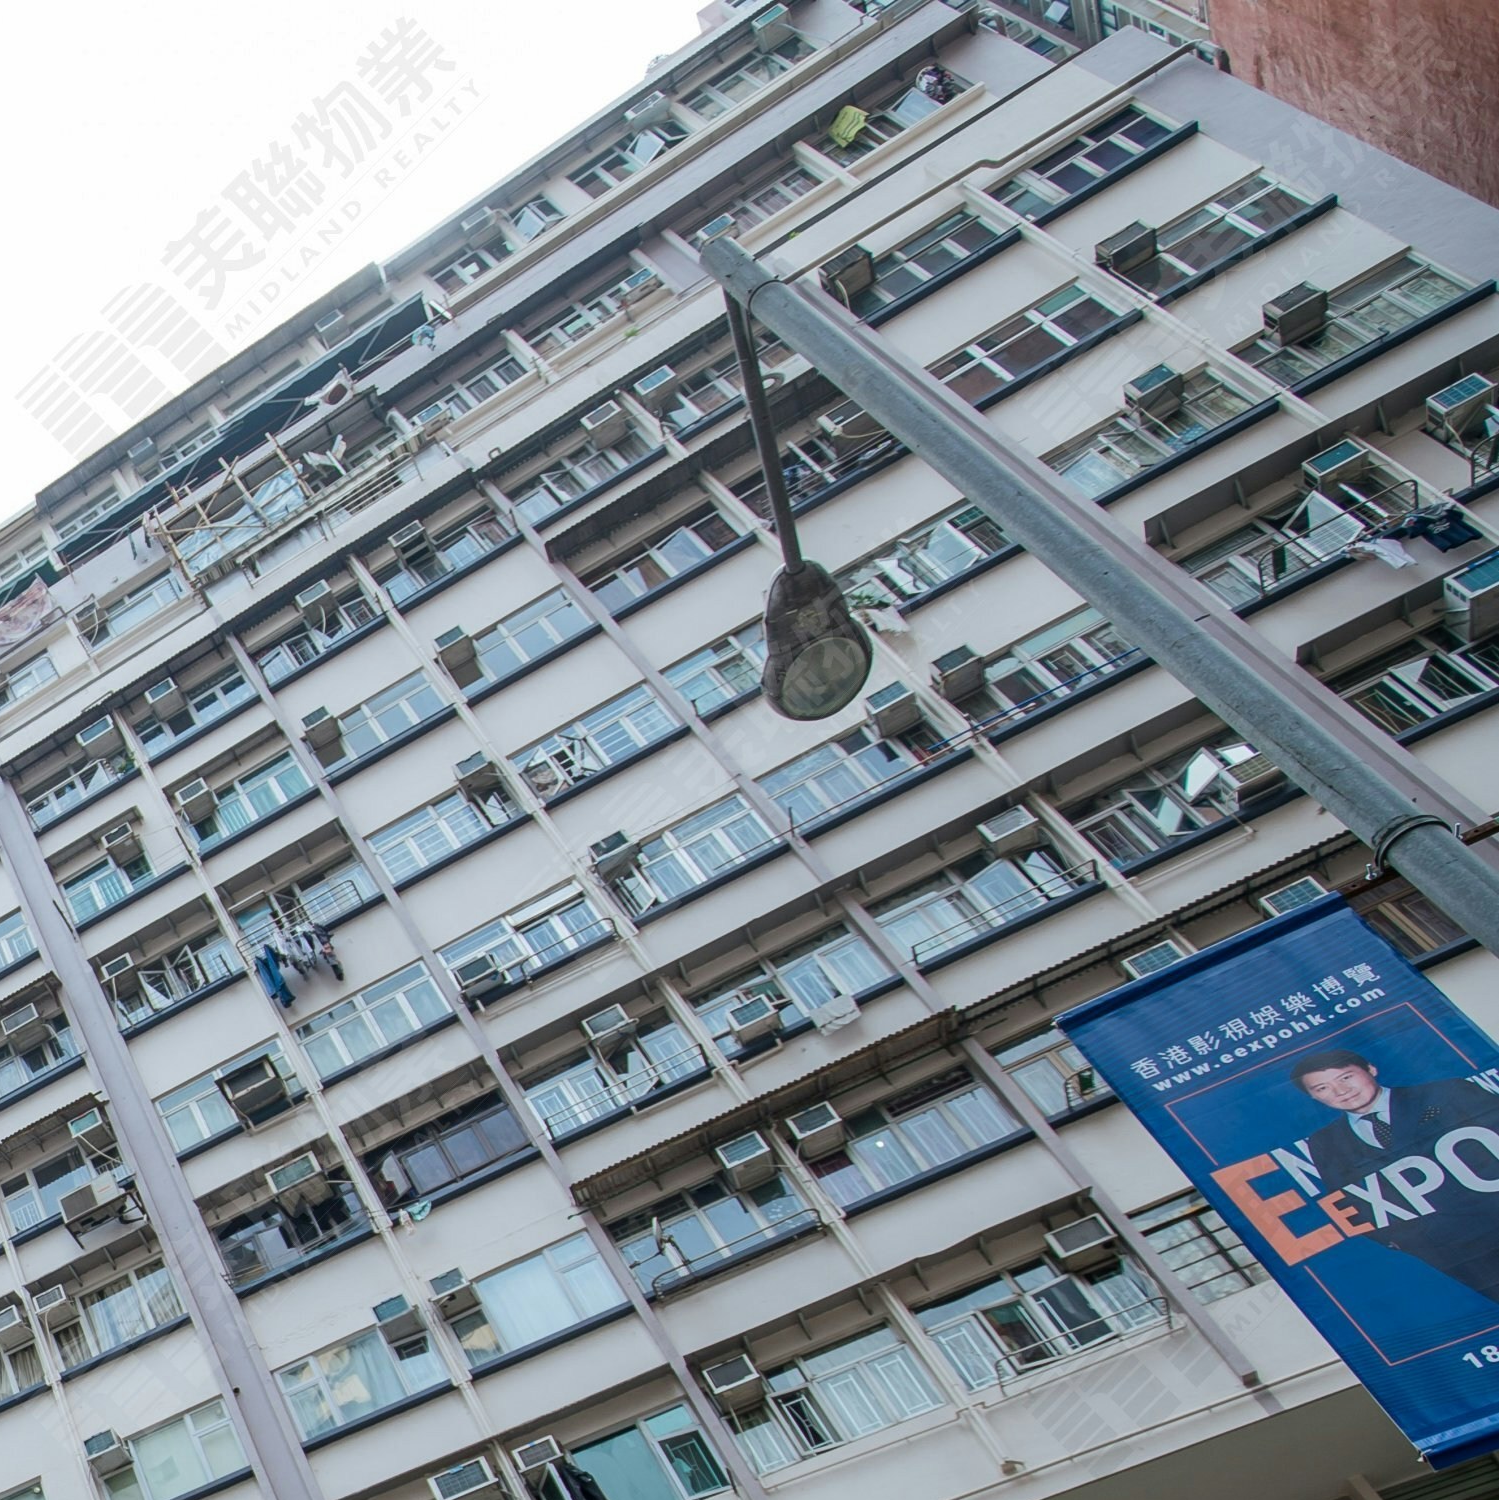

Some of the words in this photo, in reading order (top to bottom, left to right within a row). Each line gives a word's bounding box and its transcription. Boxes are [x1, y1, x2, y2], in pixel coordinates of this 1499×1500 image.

[1129, 962, 1381, 1081] 香港影視娛樂博覽
[1151, 987, 1386, 1092] www.eexpohk.com
